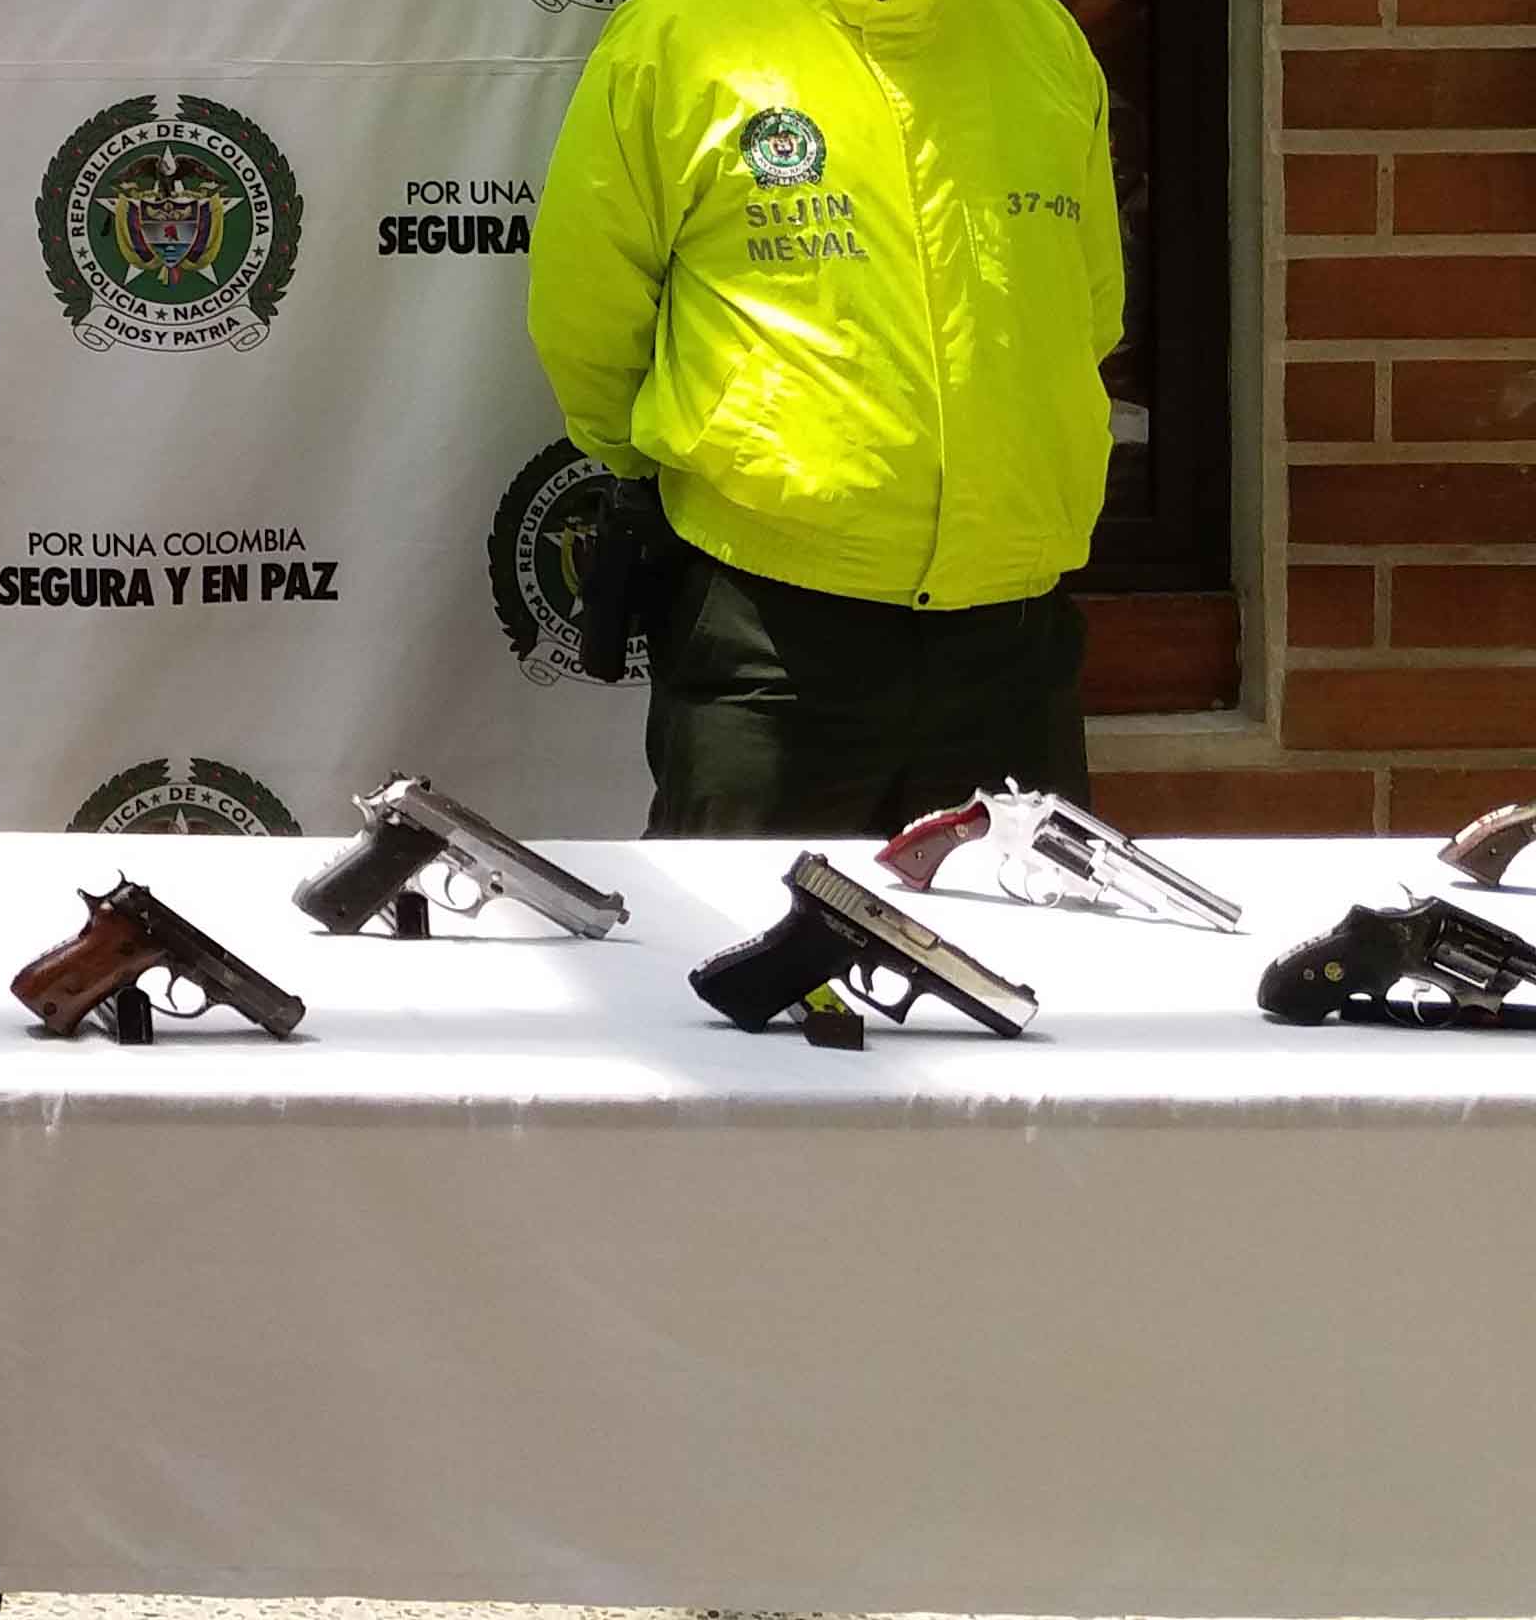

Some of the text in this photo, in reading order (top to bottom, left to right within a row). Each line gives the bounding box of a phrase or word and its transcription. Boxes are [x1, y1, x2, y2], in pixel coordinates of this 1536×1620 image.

[745, 193, 854, 229] SIJIN
[747, 231, 870, 263] MEVAL
[28, 526, 307, 559] POR UNA COLOMBIA
[163, 565, 193, 606] Y
[201, 563, 249, 605] EN
[260, 560, 340, 602] PAZ
